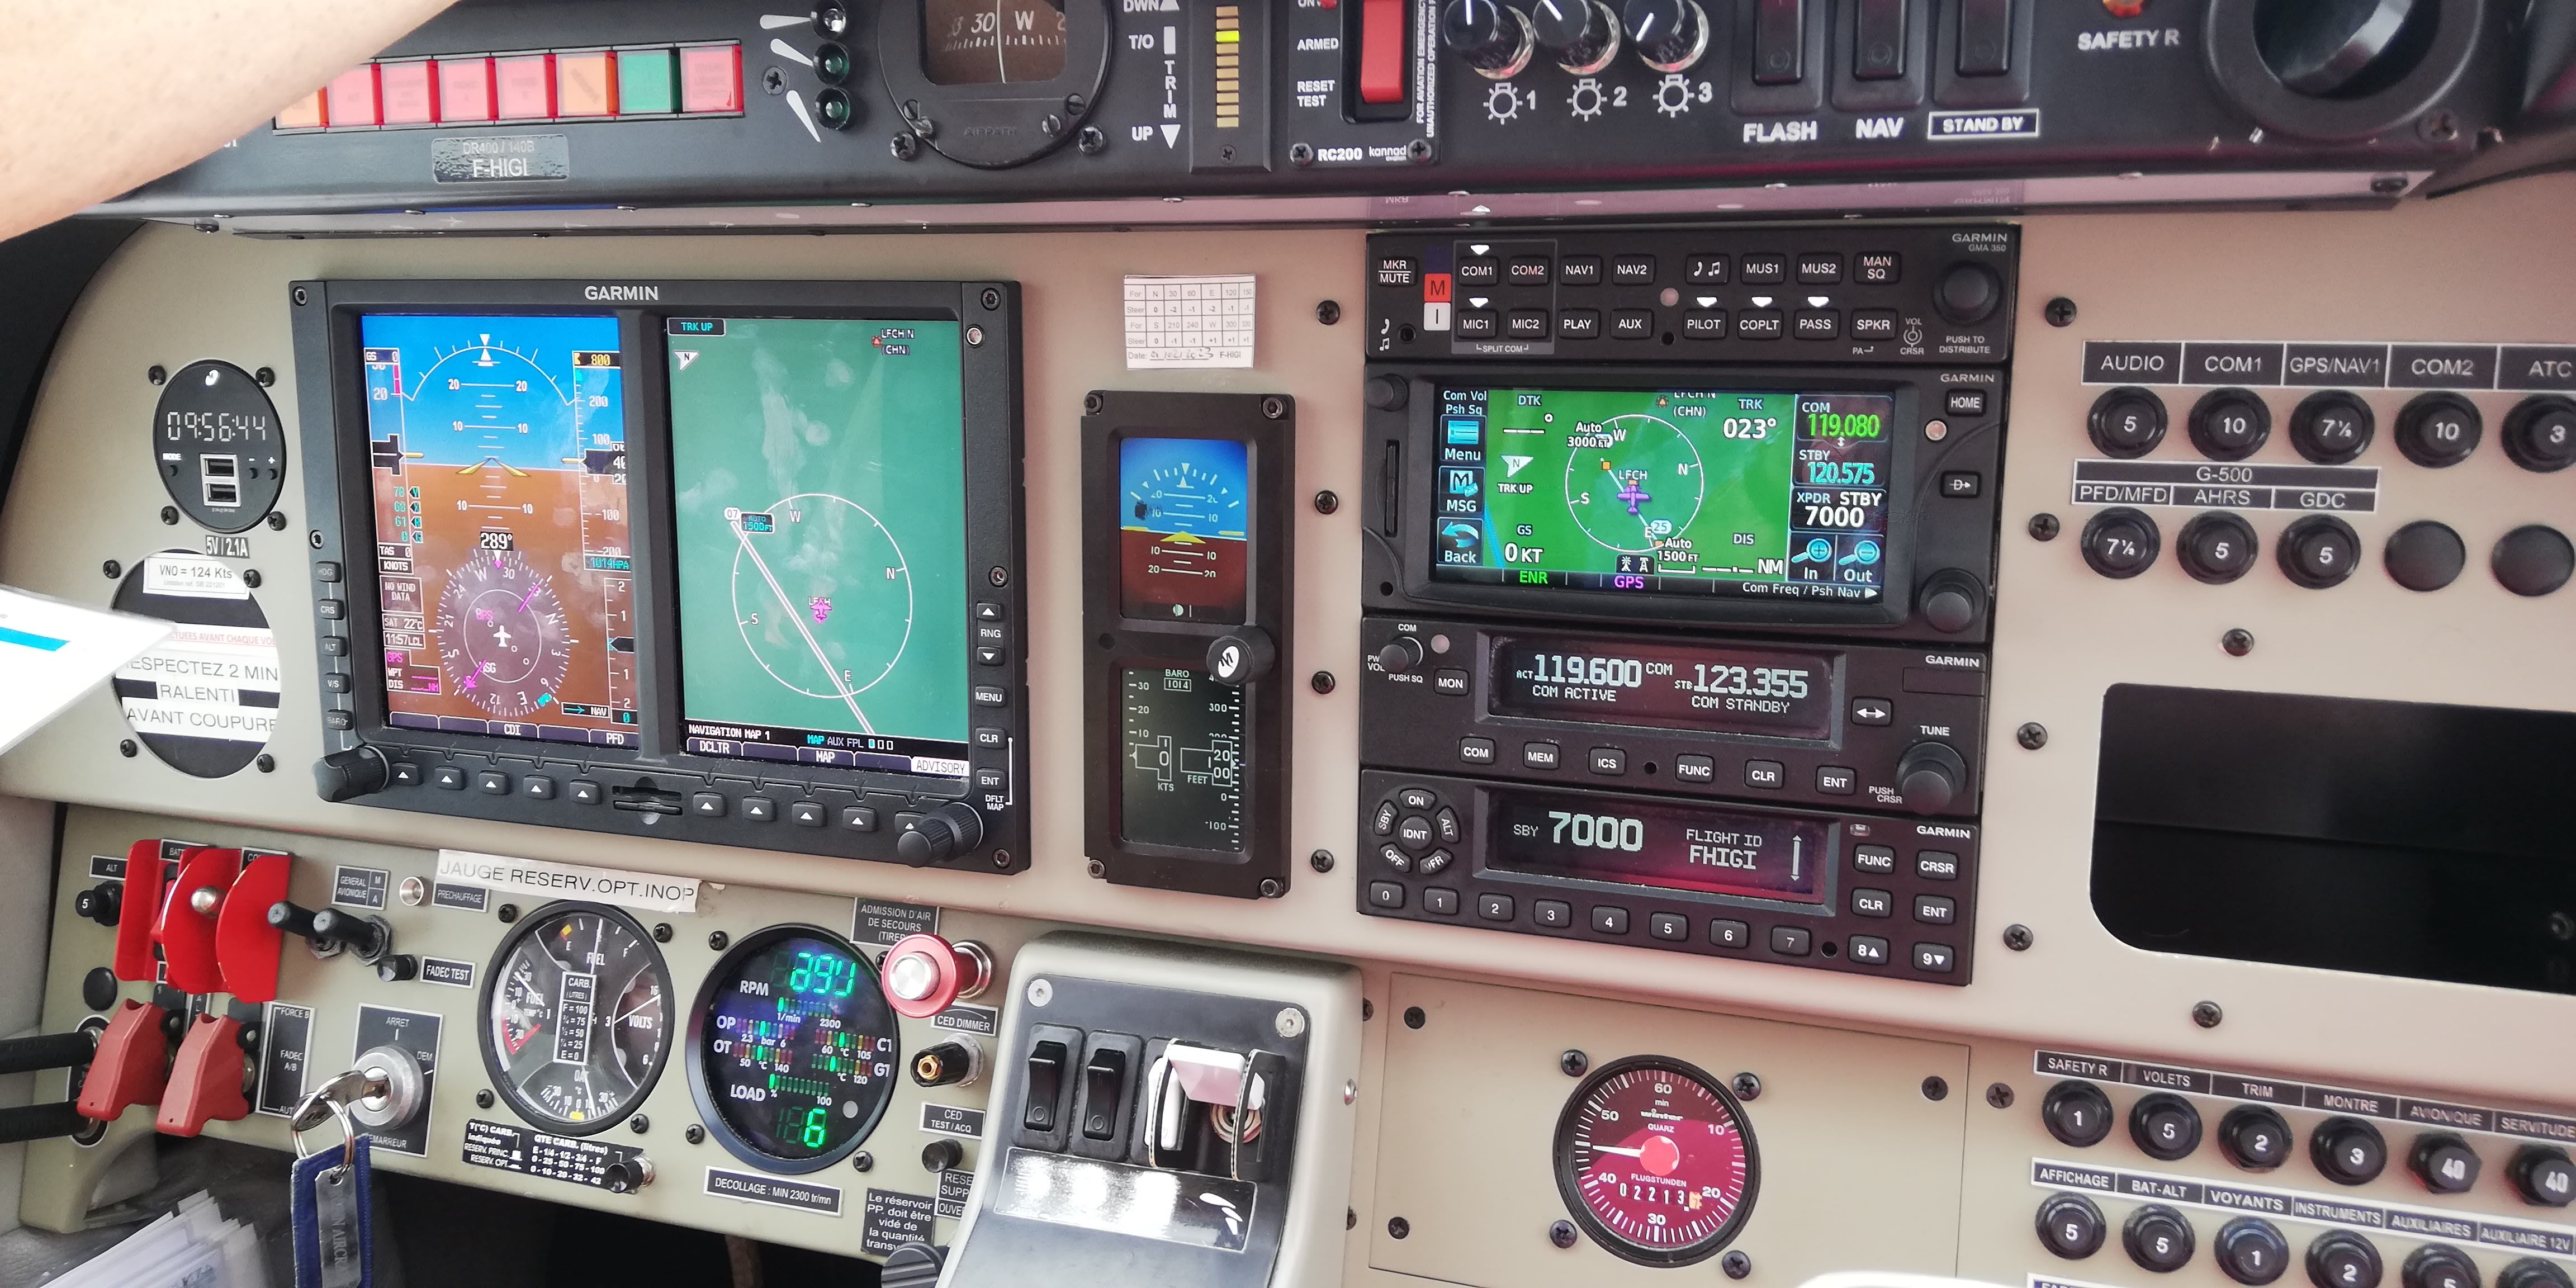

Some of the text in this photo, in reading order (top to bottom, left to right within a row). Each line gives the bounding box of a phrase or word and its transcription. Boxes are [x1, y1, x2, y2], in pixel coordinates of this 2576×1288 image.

[971, 11, 1035, 33] 30 W
[1129, 34, 1154, 49] T/O
[1298, 38, 1338, 50] ARMED
[2078, 29, 2180, 51] SAFETY R
[1298, 80, 1335, 92] RESET
[1298, 95, 1326, 107] TEST
[1743, 121, 1817, 143] FLASH
[1855, 119, 1903, 139] NAV
[1943, 117, 2023, 134] STAND BY
[1132, 126, 1153, 141] UP
[463, 141, 498, 154] DR400
[1369, 145, 1407, 157] kannad
[1318, 148, 1363, 161] RC200
[472, 158, 529, 177] F-HIGI
[1952, 233, 2007, 242] GARMIN
[1384, 260, 1407, 270] MKR
[1461, 266, 1493, 276] COM1
[1511, 265, 1544, 275] COM2
[1566, 265, 1593, 274] NAV1
[1746, 263, 1779, 273] MUS1
[1380, 273, 1409, 283] MUTE
[585, 287, 658, 300] GARMIN
[681, 323, 713, 331] TRK UP
[1463, 319, 1489, 329] MIC1
[1564, 319, 1591, 330] PLAY
[1687, 319, 1720, 329] PILOT
[1740, 320, 1779, 330] COPLT
[1800, 319, 1831, 329] PASS
[1857, 320, 1890, 329] SPKR
[1939, 345, 1990, 354] DISTRIBUTE
[2101, 356, 2164, 371] AUDIO
[2205, 357, 2262, 372] COM1
[2290, 357, 2380, 373] GPS/NAV1
[2412, 359, 2474, 376] COM2
[2528, 361, 2572, 377] ATC
[1941, 374, 1993, 382] GARMIN
[1443, 391, 1486, 401] Com Vol
[1951, 397, 1980, 408] HOME
[1739, 399, 1762, 409] TRK
[1802, 402, 1830, 413] COM
[1673, 406, 1706, 418] (CHN)
[168, 411, 265, 442] 09:56:44
[1809, 414, 1880, 437] 119.080
[1445, 448, 1480, 461] Menu
[1799, 450, 1830, 461] STBY
[1618, 470, 1647, 480] LFCH
[1808, 462, 1874, 484] 120.575
[2196, 467, 2252, 482] G-500
[1797, 492, 1882, 505] XPDR STBY
[2081, 486, 2166, 502] PFD/MFD
[2194, 490, 2250, 505] AHRS
[2300, 493, 2346, 508] GDC
[1447, 500, 1476, 512] MSG
[1805, 506, 1864, 527] 7000
[206, 537, 248, 557] 5V 2.1A
[1445, 550, 1476, 563] Back
[160, 565, 178, 576] VNO
[191, 567, 210, 577] 124
[215, 567, 232, 579] Kts
[1519, 570, 1548, 583] ENR
[1845, 569, 1872, 583] Out
[1614, 576, 1644, 588] GPS
[1925, 655, 1980, 667] GARMIN
[126, 657, 277, 681] ESPECTEZ 2 MIN
[1165, 669, 1189, 678] BARO
[1534, 655, 1641, 688] 119.600
[1438, 678, 1463, 688] MON
[1694, 664, 1808, 698] 123.355
[160, 685, 235, 703] RALENTI
[976, 693, 1002, 702] MENU
[1533, 685, 1616, 702] COM ACTIVE
[1692, 696, 1789, 713] COM STANDBY
[127, 708, 183, 724] AVANT
[591, 707, 607, 716] NAV
[504, 724, 521, 736] CDI
[689, 724, 770, 740] NAVIGATION MAP 1
[607, 733, 624, 744] PFD
[1464, 747, 1488, 757] COM
[1528, 752, 1553, 763] MEM
[917, 760, 965, 774] ADVISORY
[1598, 757, 1616, 768] ICS
[1679, 765, 1710, 776] FUNC
[1752, 771, 1775, 781] CLR
[1188, 775, 1208, 784] FEET
[1824, 777, 1846, 788] ENT
[1513, 811, 1642, 851] SBY 7000
[1917, 826, 1970, 838] GARMIN
[1686, 829, 1762, 847] FLIGHT ID
[1689, 845, 1756, 870] FHIGI
[1858, 854, 1891, 867] FUNC
[441, 861, 504, 881] JAUGE
[1920, 860, 1954, 874] CRSR
[861, 905, 907, 918] ADMISSION
[868, 917, 921, 932] DE SECOURS
[426, 965, 469, 980] FADEC TEST
[740, 981, 769, 996] RPM
[628, 1016, 652, 1029] VOLTS
[2048, 1058, 2108, 1076] SAFETY R
[2143, 1070, 2190, 1087] VOLETS
[731, 1085, 765, 1101] LOAD
[2242, 1083, 2272, 1097] TRIM
[2324, 1095, 2378, 1112] MONTRE
[1647, 1124, 1674, 1133] QUARZ
[1631, 1174, 1687, 1187] FLUGSTUNDEN
[2040, 1168, 2109, 1187] AFFICHAGE
[715, 1178, 766, 1195] DECOLLAGE
[772, 1187, 788, 1199] MIN
[790, 1190, 809, 1201] 2300
[2132, 1180, 2186, 1198] BAT-ALT
[869, 1193, 932, 1210] Le réservoir
[2210, 1191, 2283, 1211] VOYANTS
[2295, 1202, 2381, 1224] INSTRUMENTS
